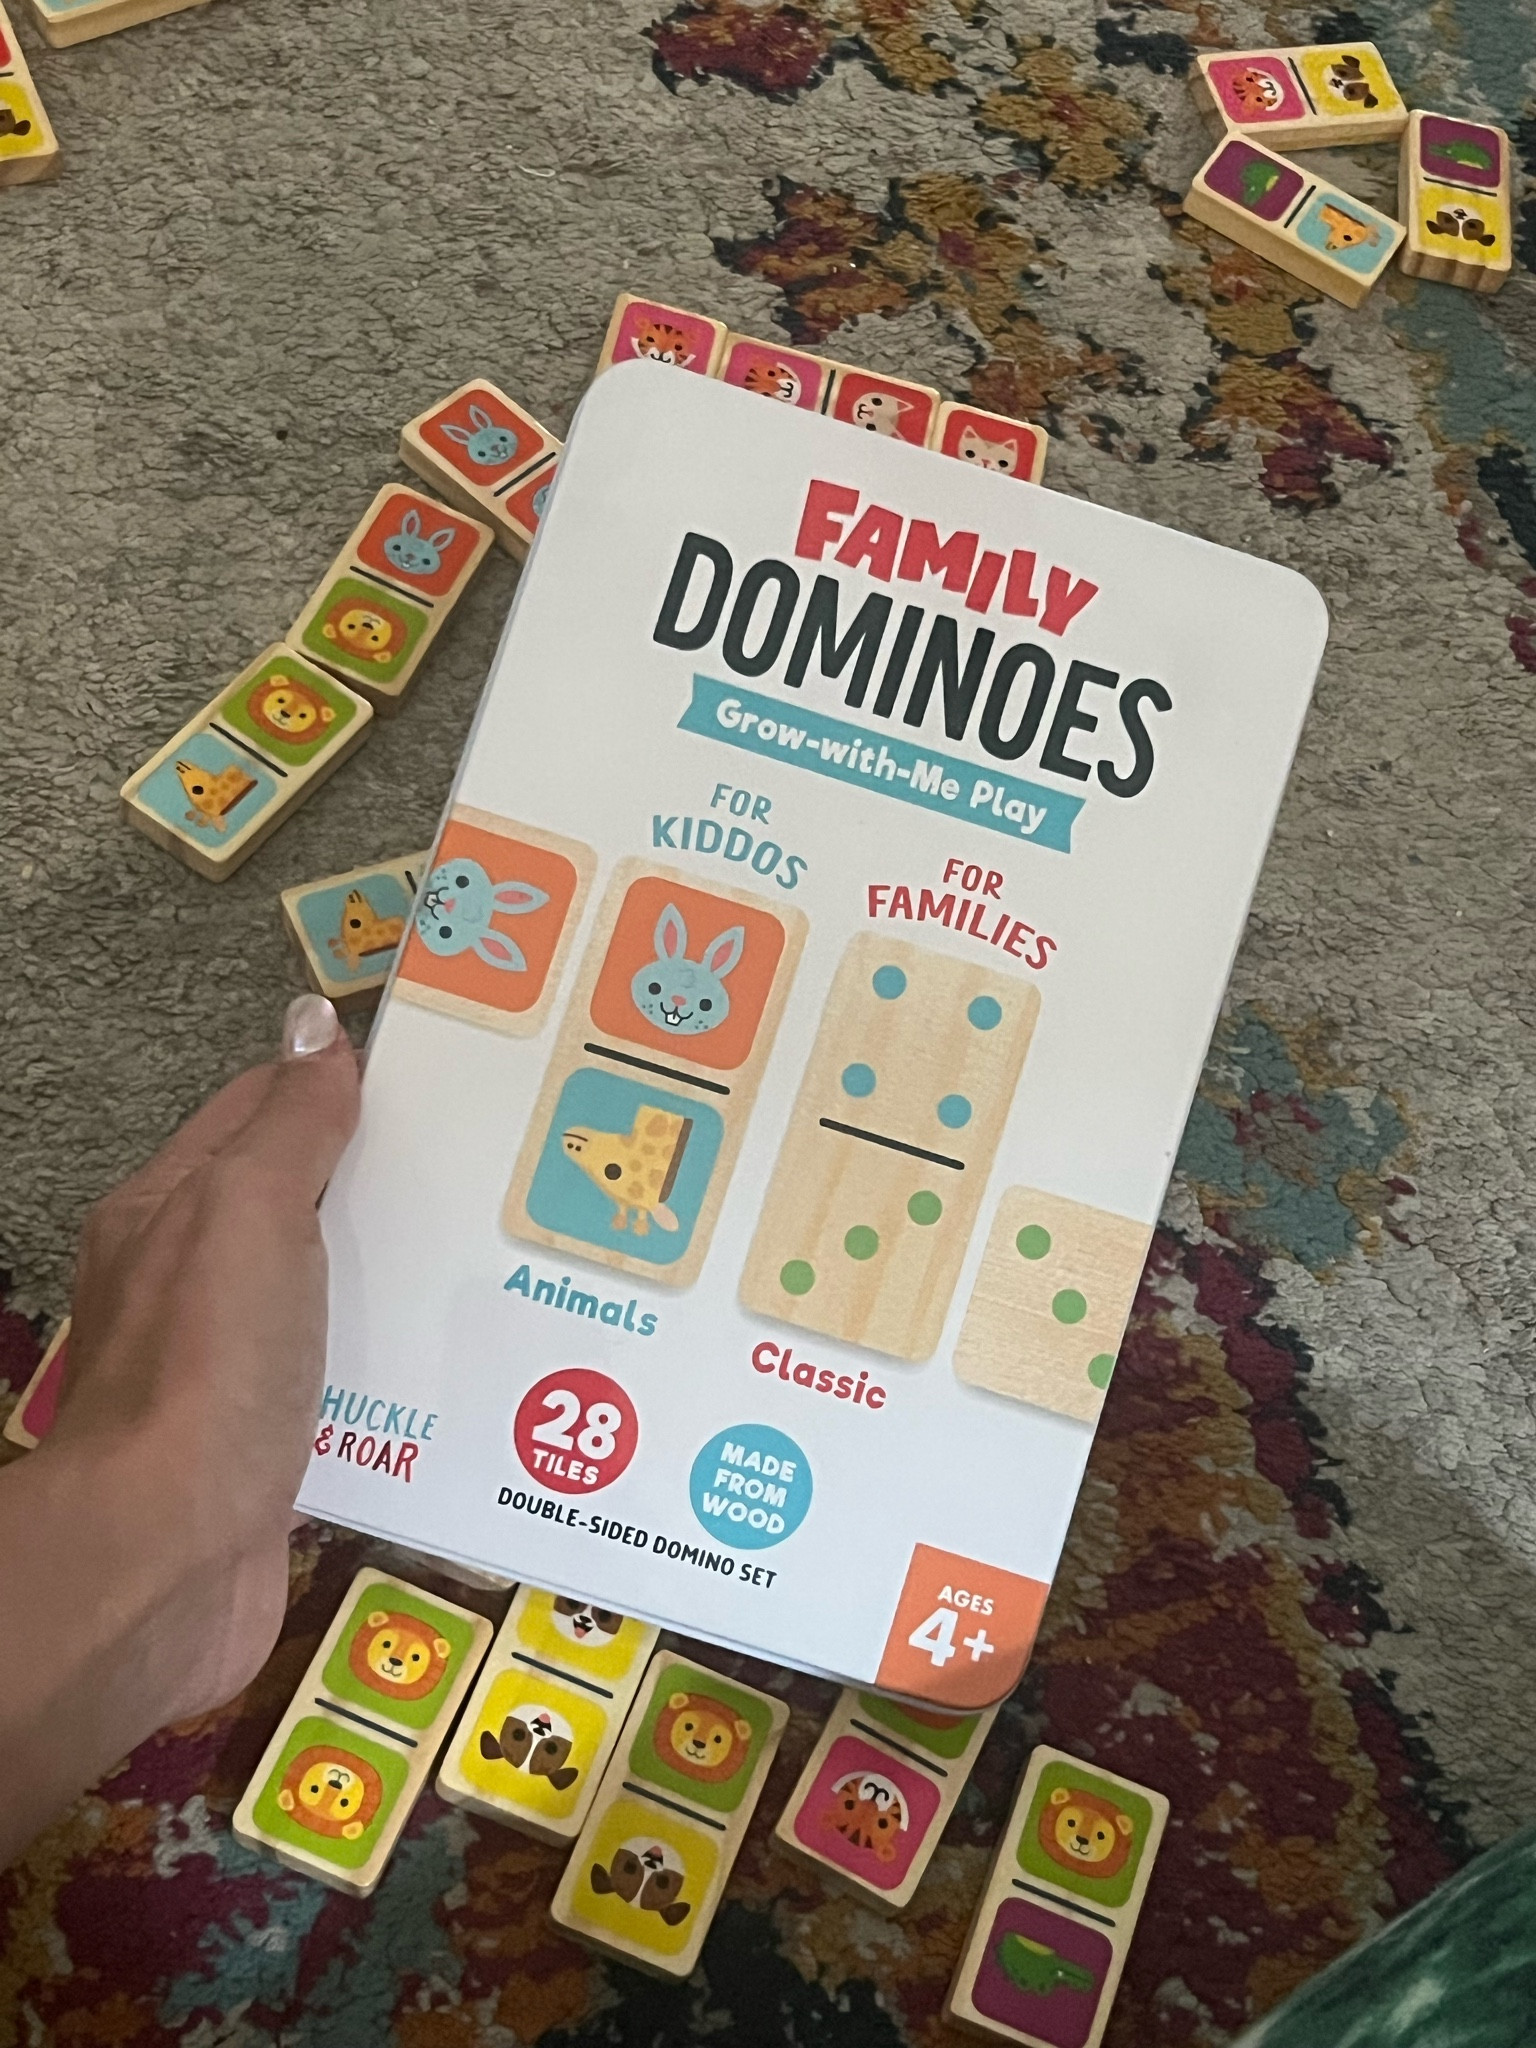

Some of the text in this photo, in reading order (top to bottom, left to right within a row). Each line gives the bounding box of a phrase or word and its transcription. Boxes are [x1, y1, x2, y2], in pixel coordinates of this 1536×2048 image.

[794, 479, 1099, 636] FAMILY
[653, 531, 1172, 798] DOMINOES
[716, 698, 1046, 835] Grow-with-Me Play
[710, 783, 772, 824] FOR
[652, 815, 808, 890] KIDDOS
[942, 859, 1004, 899] FOR
[868, 884, 1058, 969] FAMILIES
[504, 1264, 658, 1337] Animals
[751, 1342, 887, 1409] Classic
[320, 1384, 438, 1441] HUCKLE
[531, 1389, 622, 1460] 28
[314, 1425, 418, 1483] & ROAR
[532, 1448, 600, 1486] TILES
[720, 1441, 797, 1483] MADE
[702, 1492, 786, 1535] WOOD
[714, 1468, 787, 1508] FROM
[498, 1486, 777, 1589] DOUBLE-SIDED DOMINO SET
[938, 1585, 994, 1616] AGES
[908, 1607, 994, 1667] 4+
